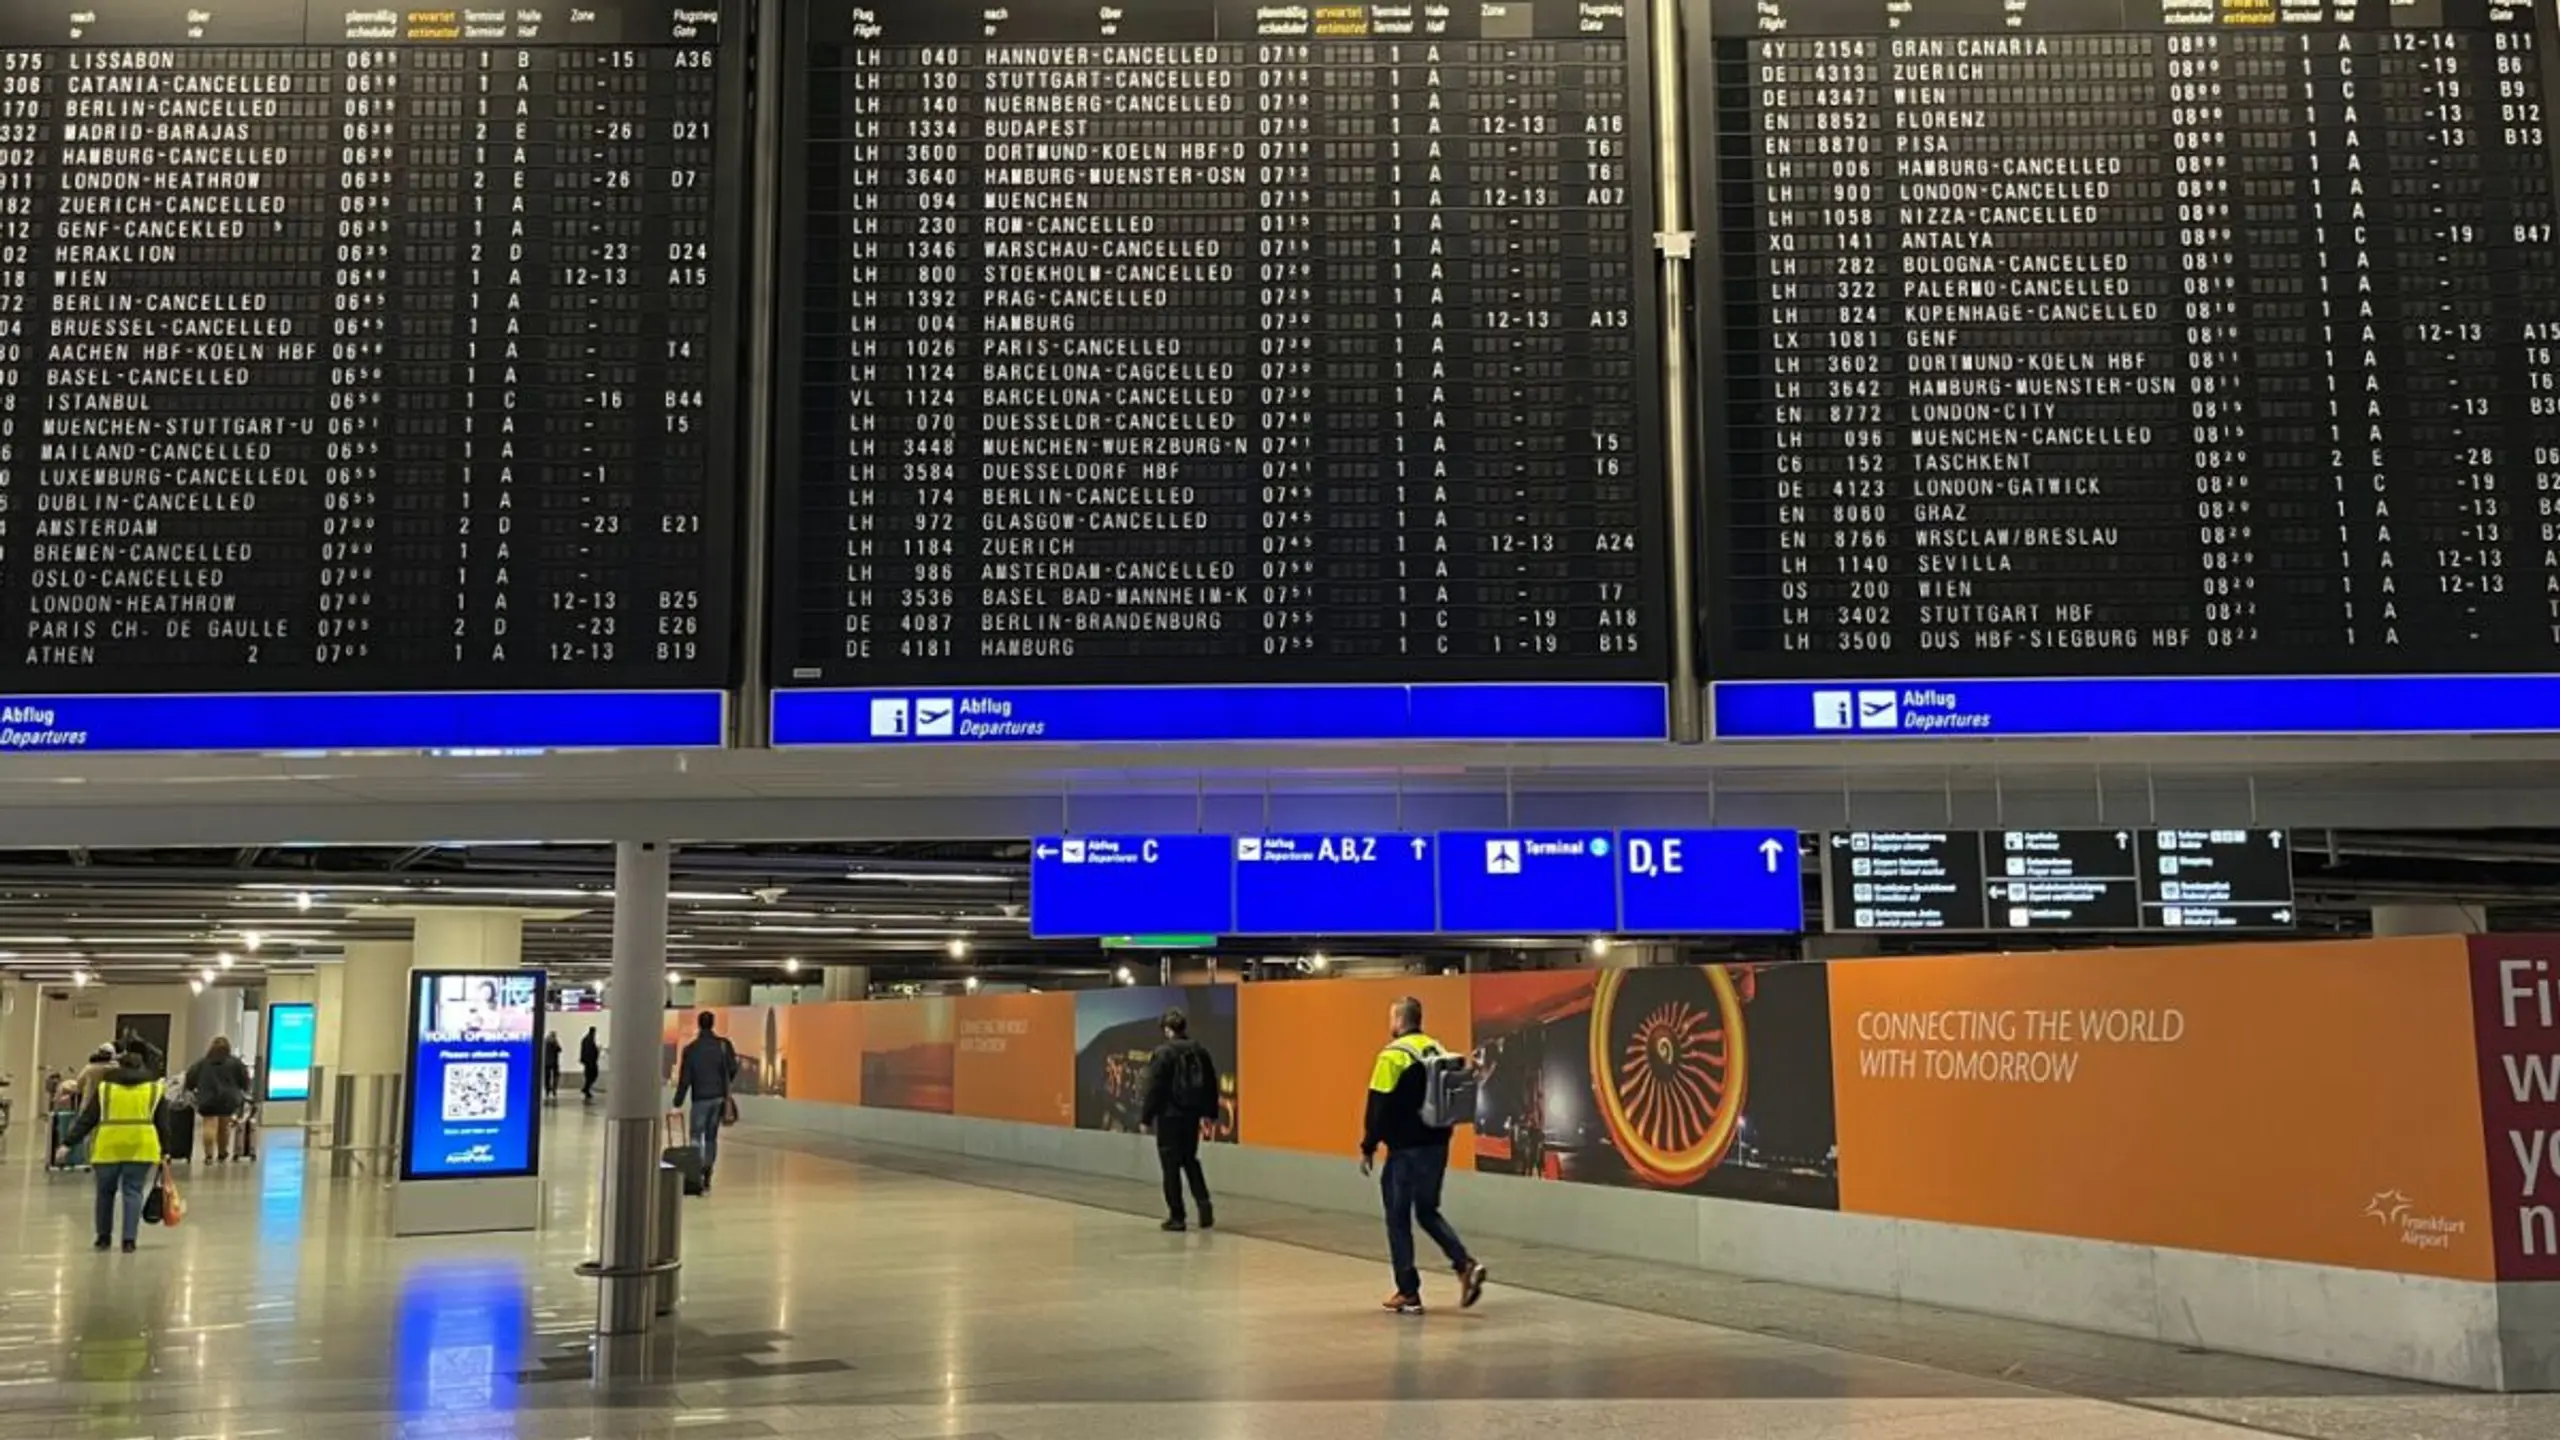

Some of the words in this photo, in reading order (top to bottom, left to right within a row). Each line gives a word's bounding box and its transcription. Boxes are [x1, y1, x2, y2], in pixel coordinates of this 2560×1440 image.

[853, 8, 874, 22] Flug
[921, 48, 958, 66] 040
[986, 46, 1218, 65] HANNOVER-CANCELLED
[1892, 39, 1943, 58] GRAN
[1957, 37, 2048, 57] CANARIA
[70, 51, 174, 70] LISSABON
[674, 50, 712, 68] A36
[923, 72, 957, 90] 130
[986, 73, 1231, 89] STUTTGART-CANCELLED
[1893, 62, 1983, 81] ZUERICH
[68, 74, 291, 93] CATANIA-CANCELLED
[923, 96, 957, 113] 140
[985, 93, 1231, 113] NUERNBERG-CANCELLED
[1894, 87, 1945, 105] WIEN
[66, 98, 277, 117] BERLIN-CANCELLED
[2502, 104, 2540, 122] B12
[909, 119, 957, 138] 1334
[985, 119, 1087, 137] BUDAPEST
[1896, 110, 1985, 129] FLORENZ
[64, 123, 249, 141] MADRID-BARAJAS
[673, 121, 709, 140] D21
[2505, 128, 2542, 146] B13
[985, 142, 1167, 161] DORTMUND-KOELN
[1896, 135, 1949, 153] PISA
[62, 147, 287, 166] HAMBURG-CANCELLED
[906, 168, 956, 185] 3640
[985, 166, 1245, 185] HAMBURG-MUENSTER-OSN
[1898, 157, 2120, 177] HAMBURG-CANCELLED
[62, 171, 260, 190] LONDON-HEATHROW
[984, 191, 1088, 209] MUENCHEN
[1587, 187, 1624, 205] A07
[1900, 181, 2109, 201] LONDON-CANCELLED
[59, 195, 285, 214] ZUERICH-CANCELLED
[985, 215, 1154, 234] ROM-CANCELLED
[1824, 208, 1872, 226] 1058
[1900, 205, 2097, 225] NIZZA-CANCELLED
[1838, 232, 1872, 249] 141
[1901, 231, 1993, 249] ANTALYA
[2514, 225, 2551, 243] B47
[55, 245, 175, 263] HERAKLION
[669, 243, 706, 260] D24
[984, 239, 1219, 258] WARSCHAU-CANCELLED
[1837, 256, 1874, 275] 282
[1903, 253, 2127, 274] BOLOGNA-CANCELLED
[54, 269, 107, 287] WIEN
[669, 267, 706, 285] A15
[984, 288, 1167, 307] PRAG-CANCELLED
[1838, 281, 1875, 299] 322
[1904, 278, 2129, 298] PALERMO-CANCELLED
[52, 293, 266, 311] BERLIN-CANCELLED
[1590, 310, 1628, 327] A13
[1905, 302, 2157, 323] KOPENHAGE-CANCELLED
[50, 318, 292, 337] BRUESSEL-CANCELLED
[984, 314, 1074, 331] HAMBURG
[984, 338, 1180, 356] PARIS-CANCELLED
[1907, 329, 1957, 347] GENF
[48, 343, 128, 361] AACHEN
[143, 343, 264, 361] HBF-KOELN
[278, 343, 316, 360] HBF
[983, 362, 1233, 381] BARCELONA-CAGCELLED
[1908, 353, 2094, 372] DORTMUND-KOELN
[2108, 352, 2145, 370] HBF
[47, 367, 249, 386] BASEL-CANCELLED
[1909, 377, 2176, 396] HAMBURG-MUENSTER-OSN
[48, 393, 149, 411] ISTANBUL
[665, 391, 702, 408] B44
[983, 387, 1233, 406] BARCELONA-CANCELLED
[983, 412, 1235, 431] DUESSELDR-CANCELLED
[1911, 403, 2055, 422] LONDON-CITY
[43, 417, 313, 436] MUENCHEN-STUTTGART-U
[1911, 427, 2151, 446] MUENCHEN-CANCELLED
[40, 442, 271, 461] MAILAND-CANCELLED
[983, 437, 1247, 456] MUENCHEN-WUERZBURG-N
[1915, 452, 2029, 471] TASCHKENT
[40, 467, 308, 486] LUXEMBURG-CANCELLEDL
[982, 462, 1126, 481] DUESSELDORF
[983, 486, 1194, 505] BERLIN-CANCELLED
[1913, 477, 2100, 497] LONDON-GATWICK
[38, 492, 255, 512] DUBLIN-CANCELLED
[982, 511, 1207, 531] GLASGOW-CANCELLED
[1914, 503, 1966, 522] GRAZ
[36, 518, 158, 537] AMSTERDAM
[662, 515, 698, 533] E21
[982, 537, 1074, 556] ZUERICH
[1596, 533, 1634, 551] A24
[33, 543, 251, 562] BREMEN-CANCELLED
[981, 561, 1234, 581] AMSTERDAM-CANCELLED
[1918, 554, 2011, 573] SEVILLA
[31, 569, 223, 588] OSLO-CANCELLED
[982, 587, 1046, 606] BASEL
[1062, 586, 1248, 606] BAD-MANNHEIM-K
[1918, 580, 1972, 598] WIEN
[31, 594, 236, 614] LONDON-HEATHROW
[659, 590, 698, 609] B25
[981, 611, 1222, 631] BERLIN-BRANDENBURG
[1920, 604, 2038, 624] STUTTGART
[2056, 603, 2093, 622] HBF
[28, 620, 96, 639] PARIS
[166, 619, 190, 638] DE
[208, 618, 287, 638] GAULLE
[659, 616, 697, 635] E26
[981, 638, 1074, 657] HAMBURG
[1920, 631, 1960, 649] DUS
[1975, 628, 2137, 648] HBF-SIEGBURG
[2152, 629, 2189, 647] HBF
[25, 645, 94, 664] ATHEN
[657, 642, 696, 660] B19
[960, 699, 1012, 717] Abflug
[1904, 690, 1956, 709] Abflug
[2, 707, 54, 725] Abflug
[1905, 712, 1990, 729] Departures
[1, 729, 87, 746] Departures
[960, 720, 1045, 738] Departures
[1143, 839, 1158, 863] C
[1318, 838, 1376, 863] A,B,Z
[1524, 839, 1584, 855] Terminal
[1629, 838, 1683, 878] D,E
[1857, 1010, 2016, 1043] CONNECTING
[2024, 1010, 2073, 1042] THE
[2080, 1009, 2184, 1043] WORLD
[1860, 1048, 1917, 1078] WITH
[1924, 1050, 2079, 1083] TOMORROW
[2402, 1214, 2466, 1234] Frankfurt
[2400, 1230, 2449, 1249] Airport
